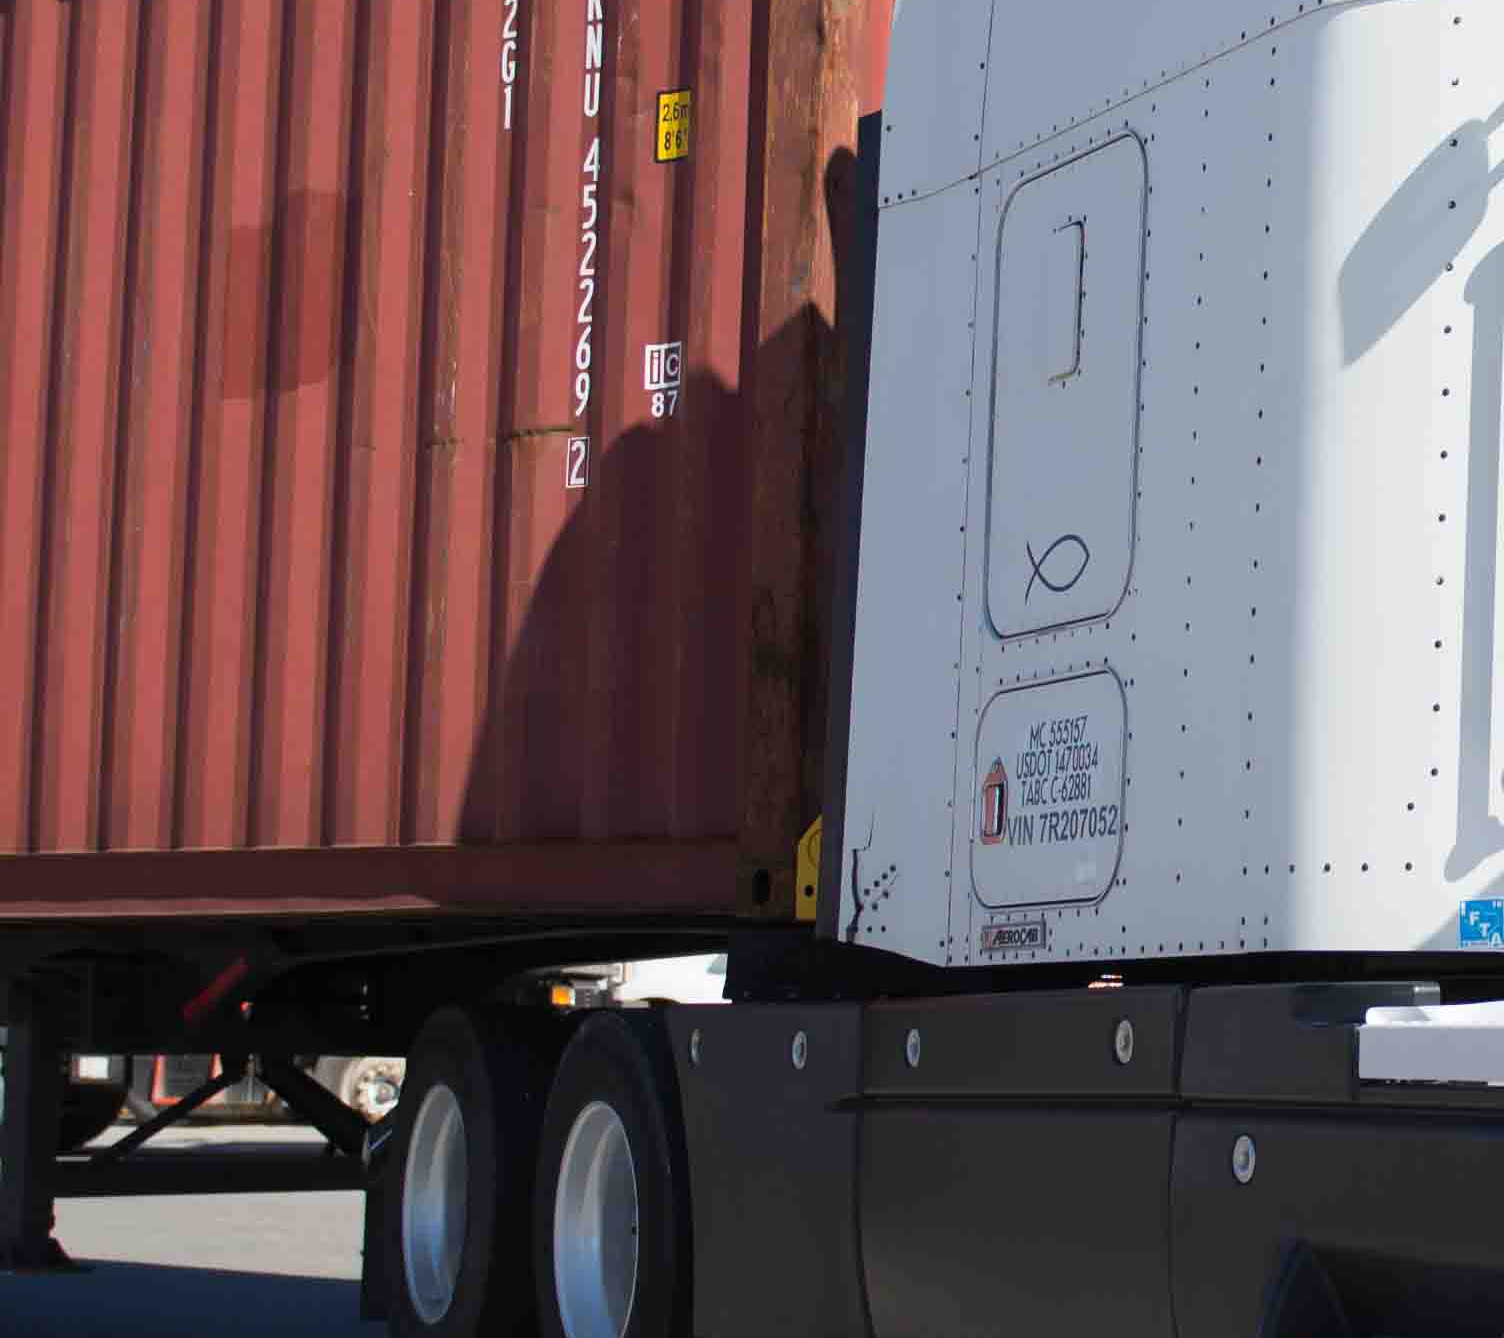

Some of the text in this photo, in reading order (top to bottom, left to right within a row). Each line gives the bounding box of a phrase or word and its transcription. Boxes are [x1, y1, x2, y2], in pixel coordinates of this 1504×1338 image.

[574, 137, 600, 417] 452269
[651, 391, 679, 418] 87
[1030, 722, 1047, 749] MC
[1016, 748, 1053, 780] USDOT
[1021, 777, 1048, 806] TABC
[1007, 804, 1118, 846] VIN 7R207052
